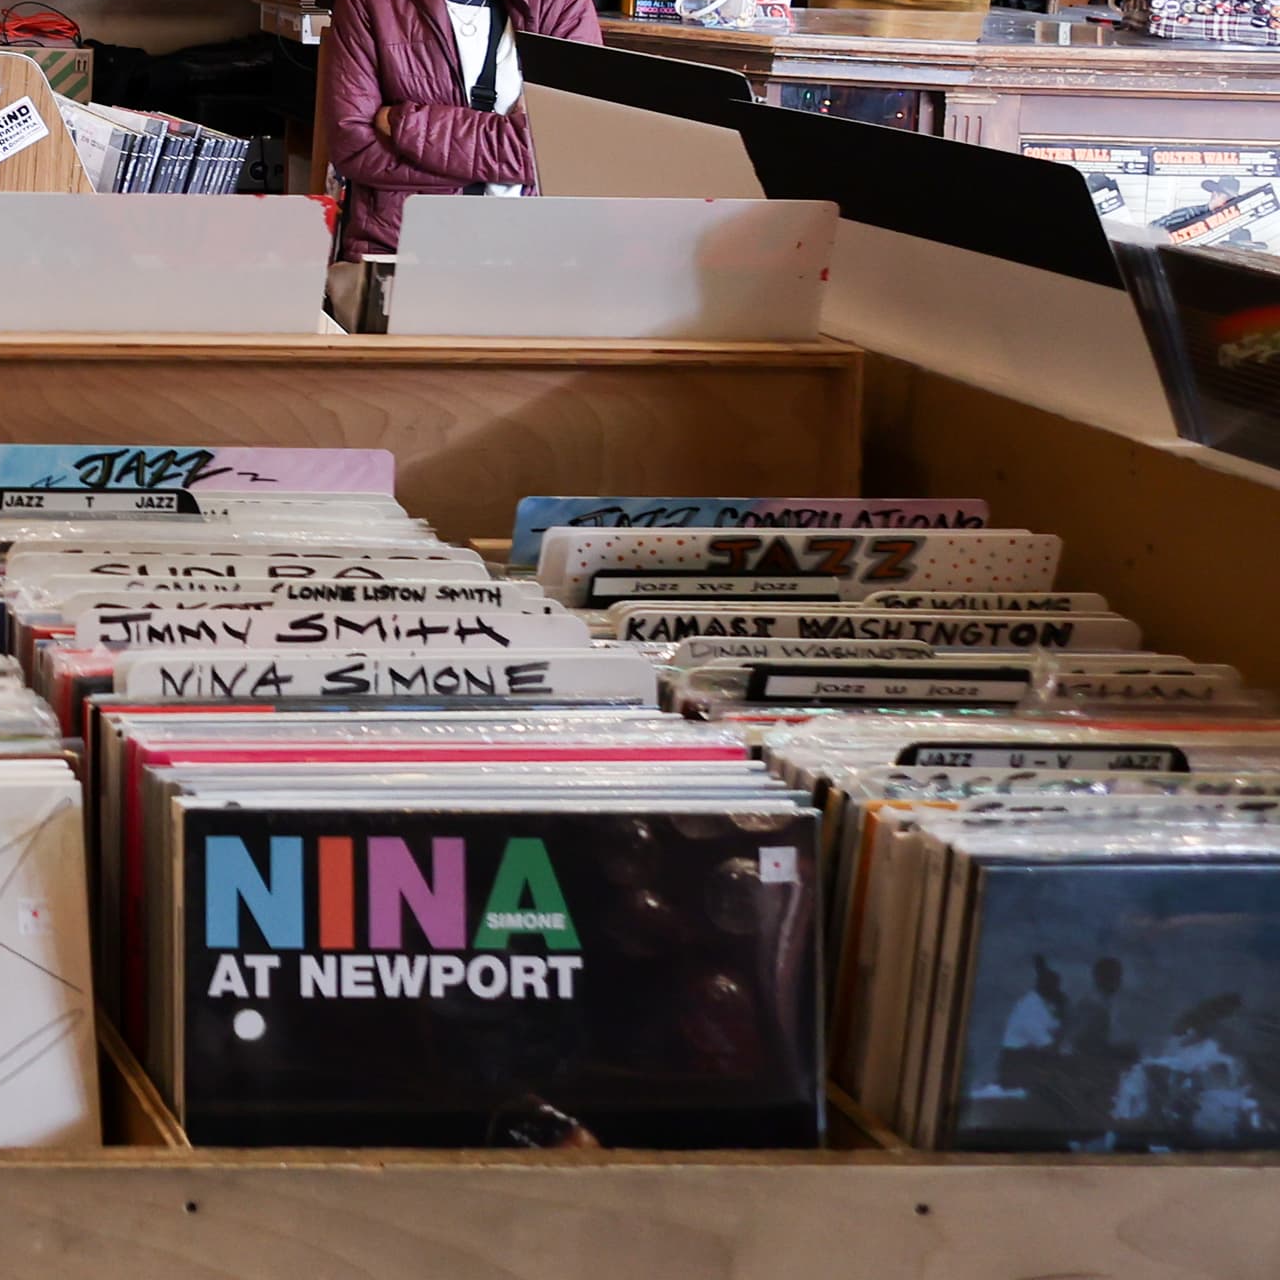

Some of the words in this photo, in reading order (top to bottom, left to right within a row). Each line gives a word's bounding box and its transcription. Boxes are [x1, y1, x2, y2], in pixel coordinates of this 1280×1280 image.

[1023, 148, 1073, 161] COLTER
[1075, 149, 1111, 162] WALL
[1153, 152, 1202, 163] COLTER
[1204, 152, 1239, 164] WALL
[1208, 205, 1241, 229] WALL
[74, 449, 233, 489] JAZZ
[5, 495, 43, 509] JAZZ
[86, 496, 94, 508] T
[136, 496, 174, 509] JAZZ
[707, 536, 921, 582] JAZZ
[287, 585, 356, 602] LONNIE
[362, 585, 425, 602] LISTON
[439, 587, 502, 606] SMITH
[626, 615, 776, 641] KAMASI
[799, 617, 1075, 648] WASHINGTON
[920, 753, 974, 766] JAZZ
[1109, 755, 1162, 769] JAZZ
[205, 835, 582, 951] NINA
[485, 912, 566, 930] SIMONE
[206, 954, 282, 998] AT
[299, 954, 584, 1000] NEWPORT
